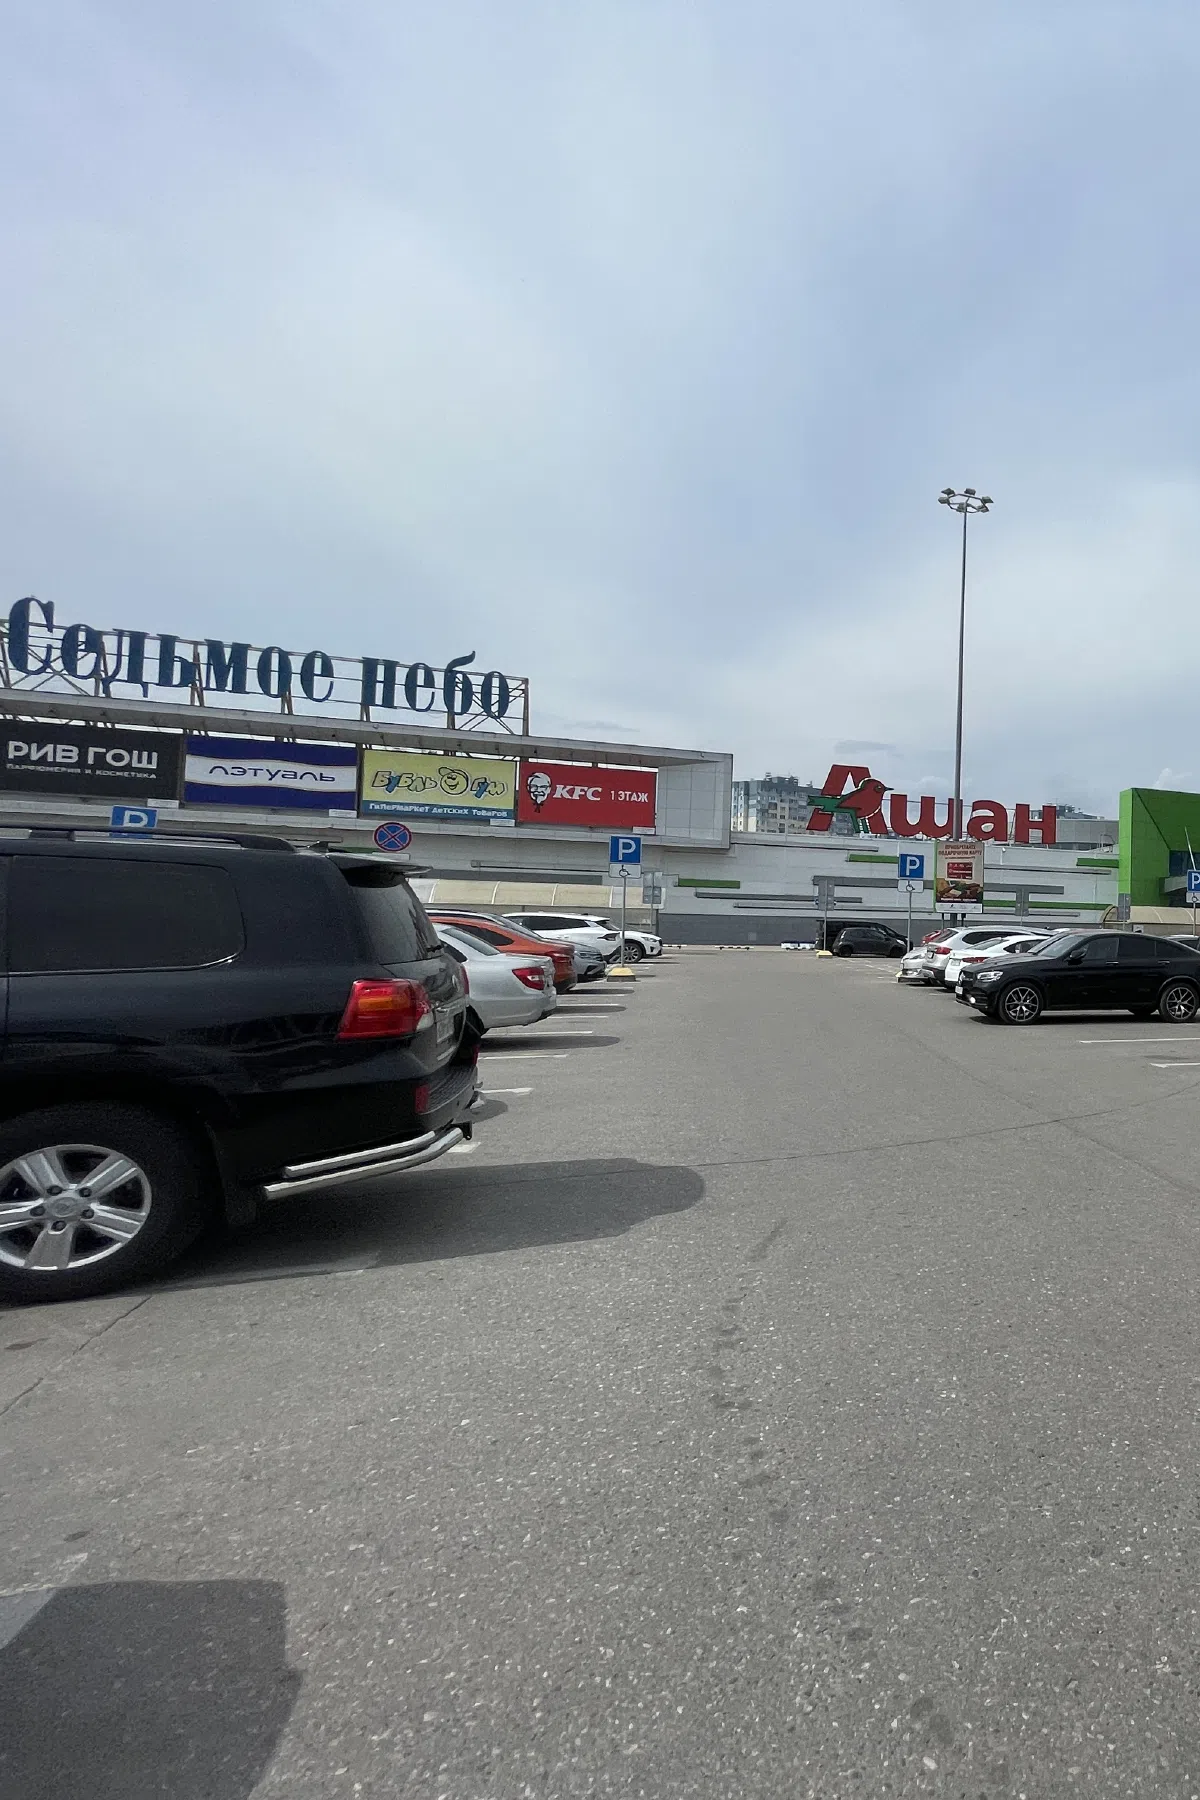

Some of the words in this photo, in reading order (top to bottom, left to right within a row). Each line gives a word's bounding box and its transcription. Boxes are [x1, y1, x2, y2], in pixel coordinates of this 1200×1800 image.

[8, 597, 334, 702] Седьмое
[361, 650, 509, 719] небо
[7, 740, 79, 763] РИВ
[87, 746, 158, 769] ГОШ
[95, 769, 157, 780] КОСМЕТИКА
[553, 785, 602, 801] KFC
[610, 790, 615, 801] 1
[618, 790, 649, 803] ЭТАЖ
[806, 764, 1057, 844] Ашан
[619, 839, 636, 860] P
[906, 856, 919, 875] P
[1191, 873, 1200, 890] P
